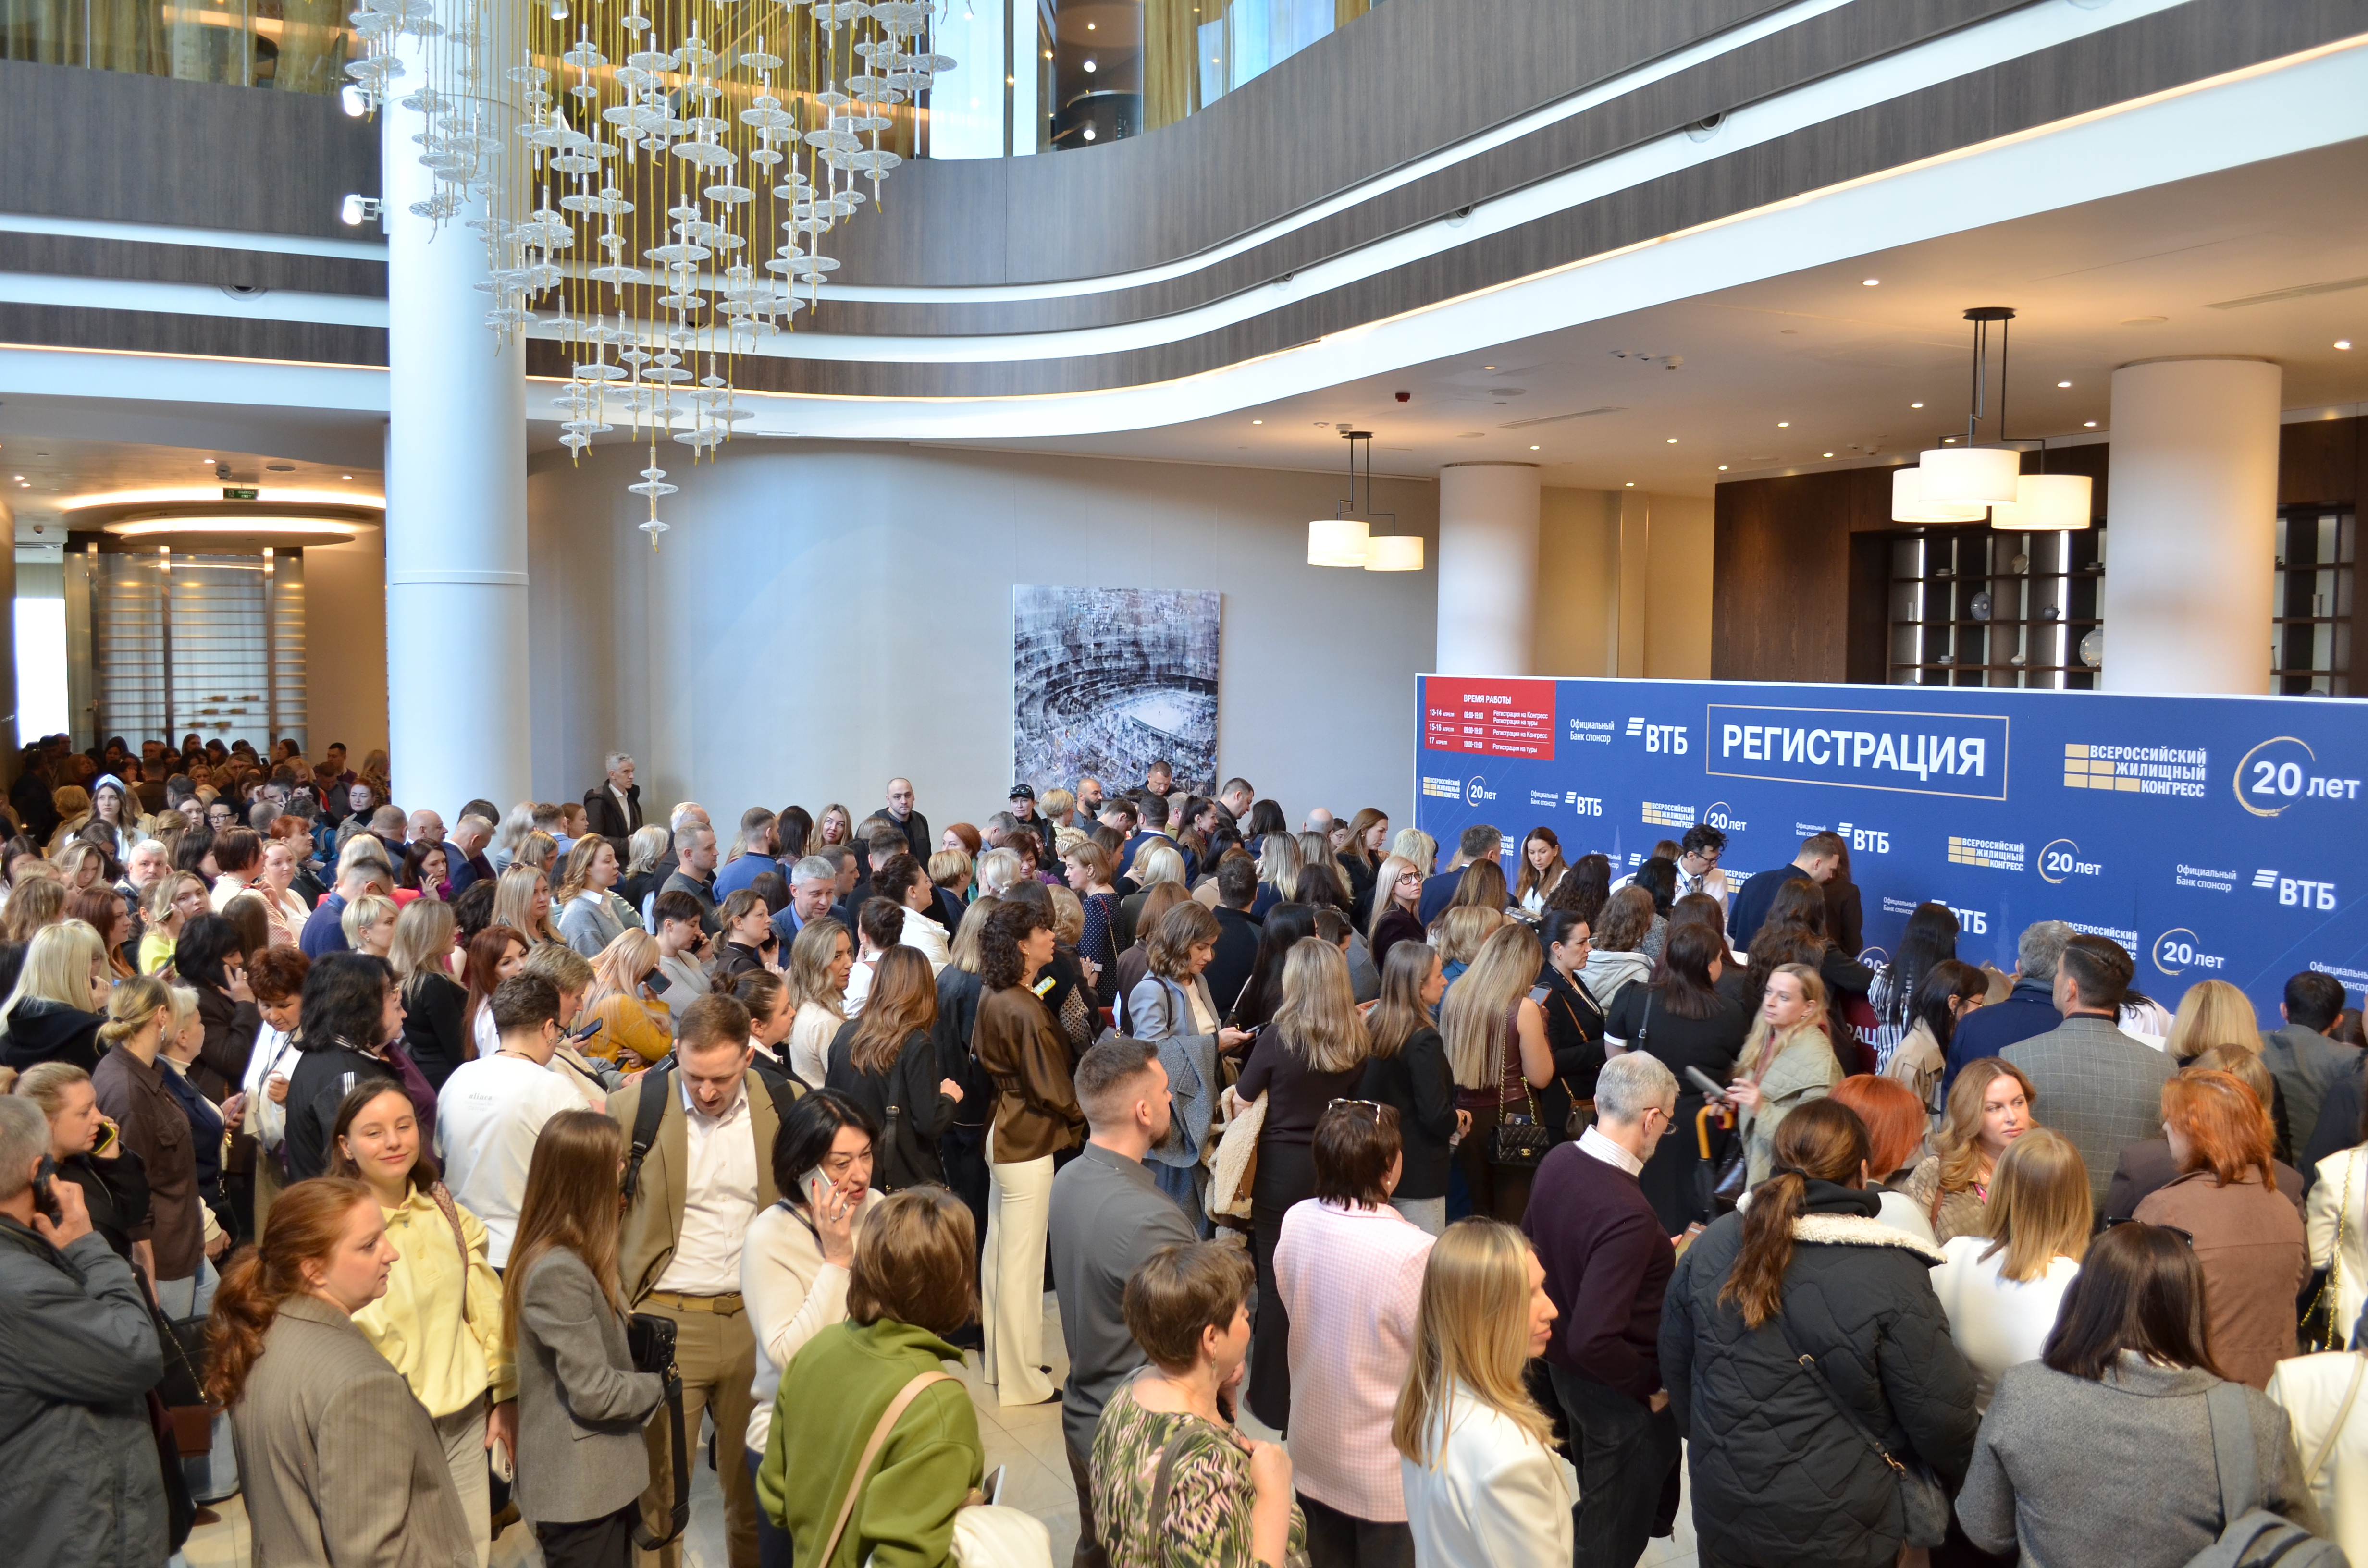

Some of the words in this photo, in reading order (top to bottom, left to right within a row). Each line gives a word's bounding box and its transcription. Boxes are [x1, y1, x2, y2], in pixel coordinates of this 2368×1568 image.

[1464, 694, 1485, 703] ВРЕМЯ
[1486, 695, 1511, 704] РАБОТЫ
[1493, 710, 1520, 718] Регистрация
[1527, 711, 1548, 720] Конгресс
[1493, 717, 1520, 725] Регистрация
[1429, 723, 1442, 731] 15-16
[1570, 719, 1615, 730] Официальный
[1492, 729, 1519, 737] Регистрация
[1527, 731, 1548, 739] Конгресс
[1570, 731, 1585, 741] Банк
[1586, 734, 1611, 745] спонсор
[1646, 724, 1688, 755] ВТБ
[1492, 743, 1519, 752] Регистрация
[1723, 724, 1985, 781] РЕГИСТРАЦИЯ
[2090, 745, 2206, 764] ВСЕРОССИЙСКИЙ
[2116, 762, 2206, 781] ЖИЛИЩНЫЙ
[1430, 778, 1460, 786] ВСЕРОССИЙСКИЙ
[2252, 761, 2302, 796] 20
[2306, 777, 2360, 799] лет
[1437, 784, 1460, 793] ЖИЛИЩНЫЙ
[1471, 785, 1483, 799] 20
[1484, 791, 1497, 800] лет
[1530, 790, 1558, 799] Официальный
[2141, 780, 2205, 797] КОНГРЕСС
[1577, 796, 1602, 816] ВТБ
[1652, 802, 1694, 814] ВСЕРОССИЙСКИЙ
[1662, 811, 1694, 821] ЖИЛИЩНЫЙ
[1710, 812, 1727, 829] 20
[1728, 821, 1747, 831] лет
[1671, 820, 1694, 829] КОНГРЕСС
[1796, 822, 1826, 831] Официальный
[1853, 829, 1889, 853] ВТБ
[1962, 838, 2024, 853] ВСЕРОССИЙСКИЙ
[1976, 848, 2024, 862] ЖИЛИЩНЫЙ
[1989, 859, 2023, 871] КОНГРЕСС
[2047, 852, 2073, 872] 20
[2074, 862, 2102, 875] лет
[2176, 864, 2236, 880] Официальный
[2176, 876, 2196, 886] Банк
[2197, 881, 2232, 893] спонсор
[2279, 878, 2335, 910] ВТБ
[1883, 897, 1916, 907] Официальный
[1895, 907, 1914, 916] спонсор
[2163, 941, 2192, 964] 20
[2194, 953, 2224, 968] лет
